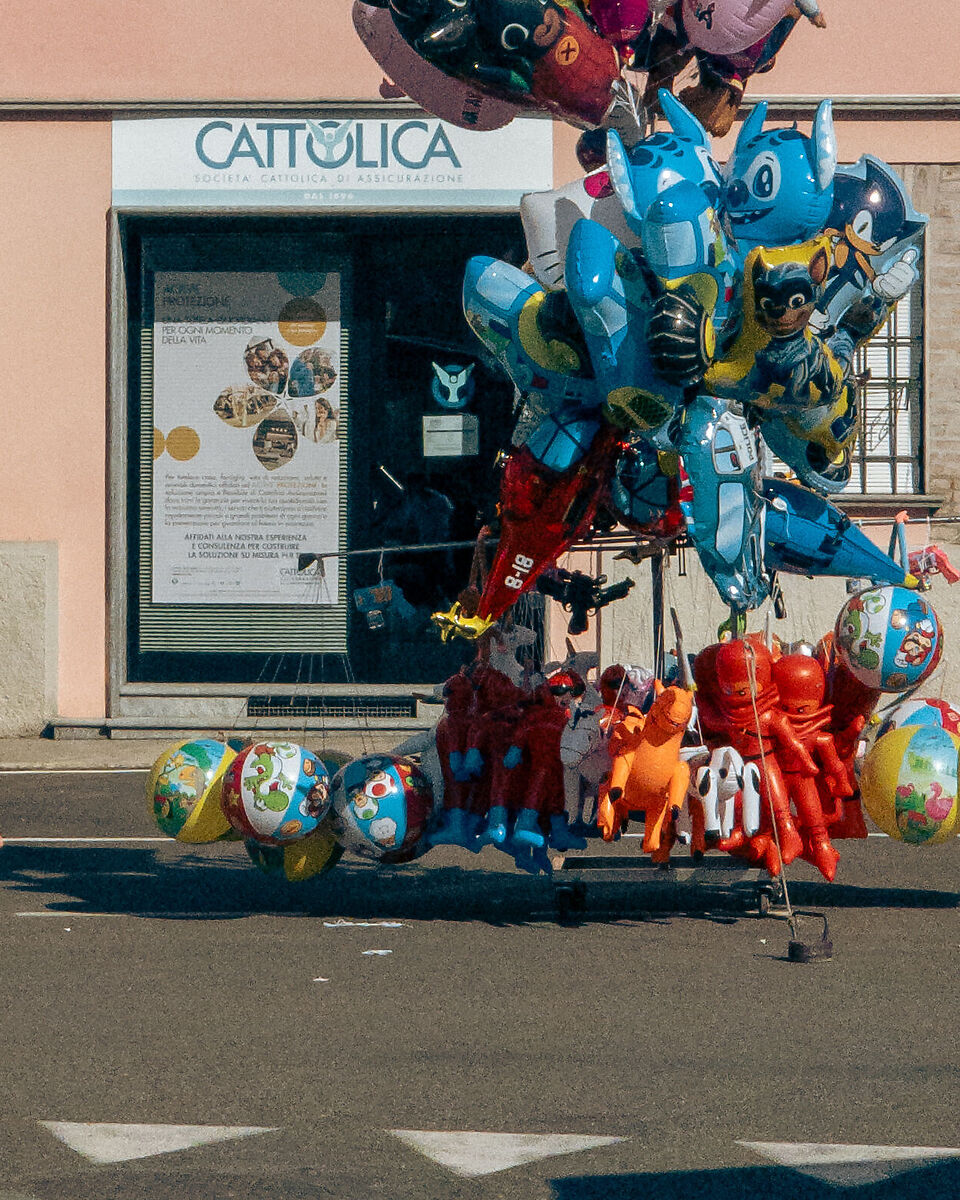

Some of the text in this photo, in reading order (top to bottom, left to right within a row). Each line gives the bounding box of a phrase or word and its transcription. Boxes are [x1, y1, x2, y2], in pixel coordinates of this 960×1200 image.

[195, 120, 462, 169] CATTOLICA
[261, 174, 328, 184] CATTOLICA
[337, 174, 348, 184] DI
[357, 174, 464, 184] ASSICURAZIONE
[162, 326, 253, 335] PER OGNI MOMENTO
[161, 335, 207, 344] DELLA VITA
[740, 422, 754, 461] POLICE
[216, 533, 233, 541] ALLA
[235, 533, 264, 541] NOSTRA
